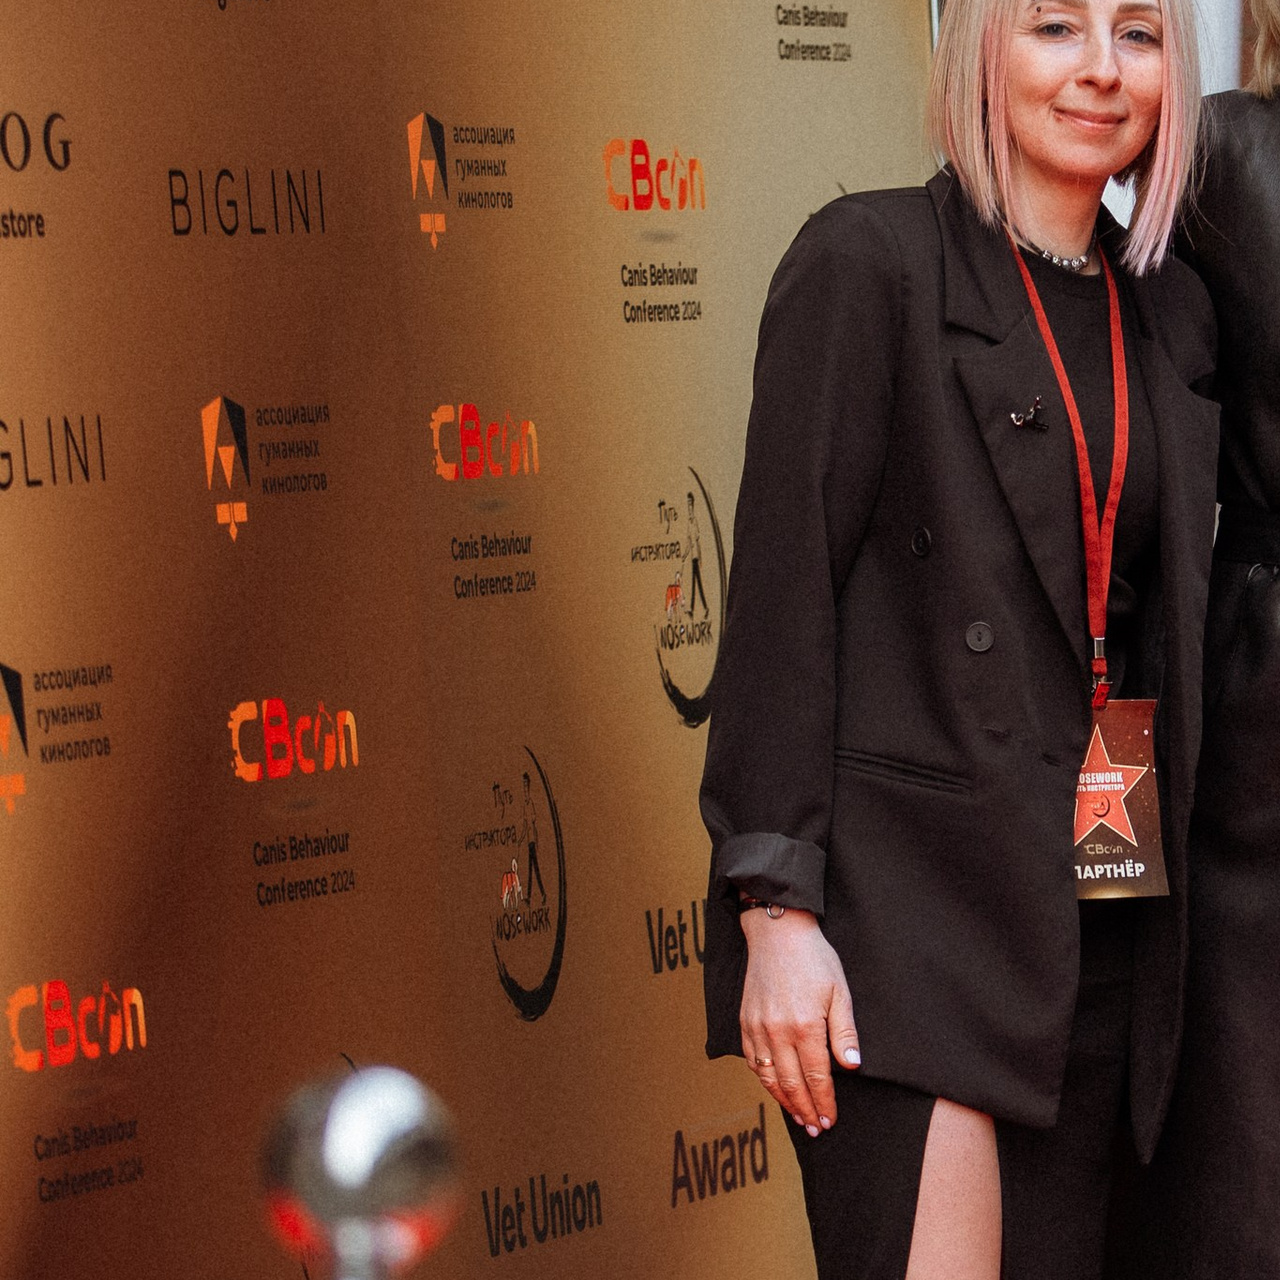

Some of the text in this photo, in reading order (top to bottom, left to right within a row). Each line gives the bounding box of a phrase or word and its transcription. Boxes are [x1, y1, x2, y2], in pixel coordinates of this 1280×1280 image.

[778, 39, 832, 60] Conference
[453, 126, 516, 147] ассоциация
[455, 159, 507, 182] гуманных
[603, 138, 706, 211] CBcon
[168, 169, 326, 236] BIGLINI
[458, 192, 513, 209] кинологов
[621, 261, 698, 287] Canis Behaviour
[623, 299, 702, 323] Conference 2024
[255, 405, 330, 427] ассоциация
[258, 439, 320, 466] гуманных
[430, 403, 540, 481] CBcon
[262, 472, 328, 495] кинологов
[451, 530, 532, 561] Canis Behaviour
[454, 571, 537, 599] Conference 2024
[34, 665, 113, 691] ассоциация
[37, 702, 103, 733] гуманных
[41, 736, 111, 764] кинологов
[228, 697, 359, 782] CBcon
[1079, 771, 1124, 784] OSEWORK
[254, 829, 350, 866] Canis Behaviour
[257, 871, 356, 907] Conference 2024
[645, 908, 689, 974] Vet
[6, 979, 147, 1072] CBcon
[671, 1103, 769, 1209] Award
[37, 1168, 114, 1203] Conference
[481, 1173, 603, 1258] Vet Union
